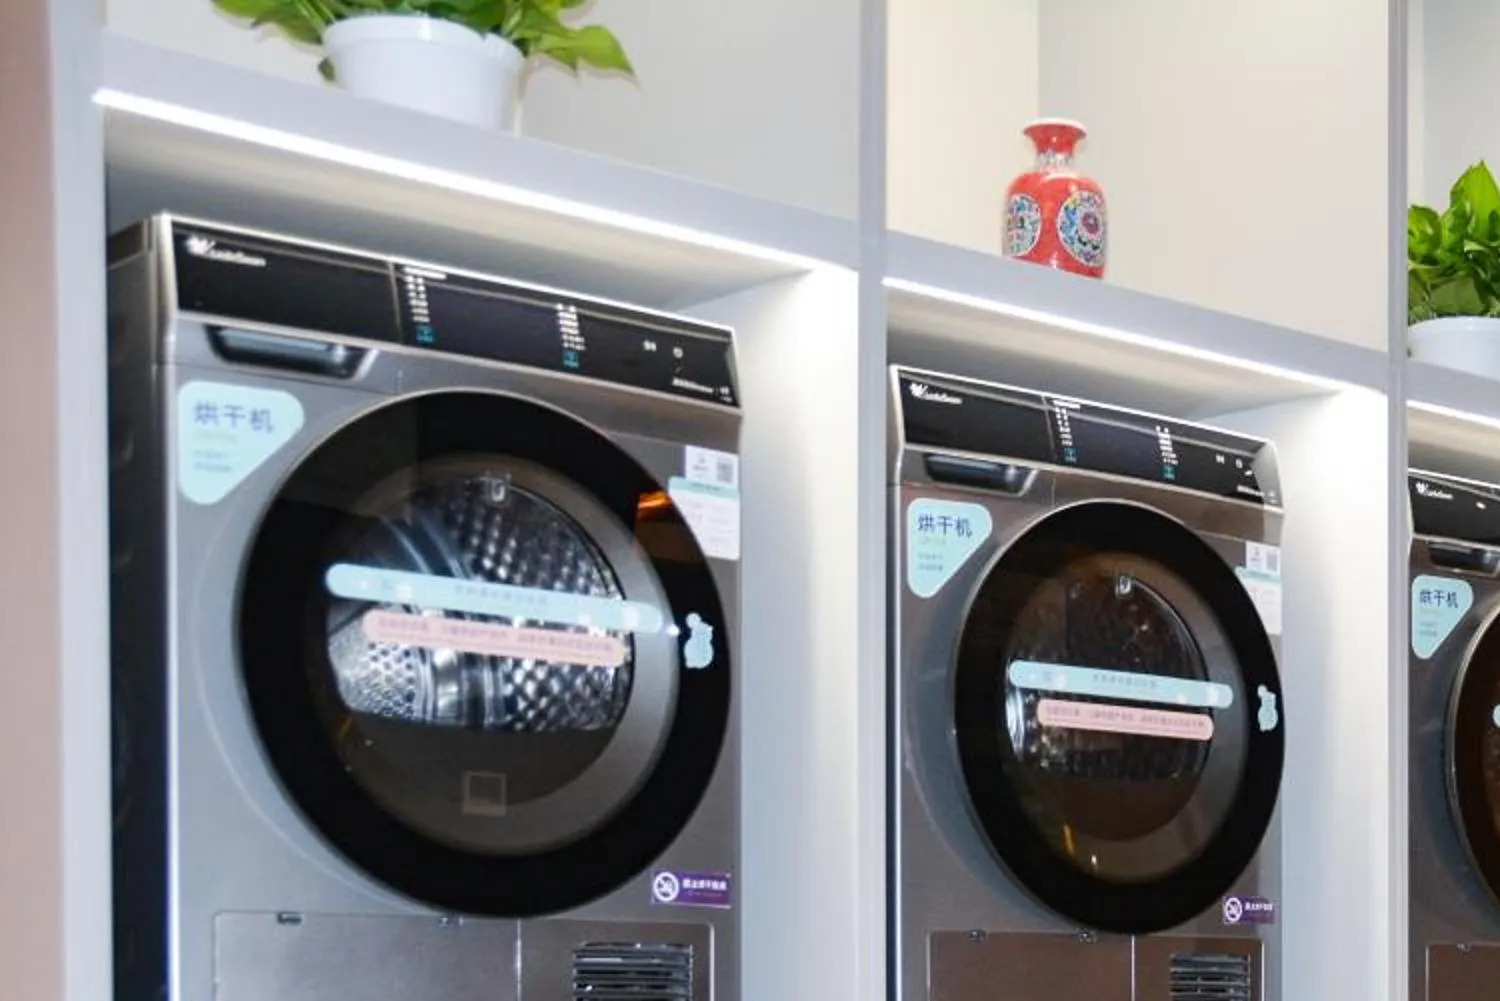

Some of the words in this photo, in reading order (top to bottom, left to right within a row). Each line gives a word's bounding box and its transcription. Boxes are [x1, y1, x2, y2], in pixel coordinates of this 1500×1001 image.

[917, 513, 972, 538] 烘干机
[1419, 588, 1459, 609] 烘干机
